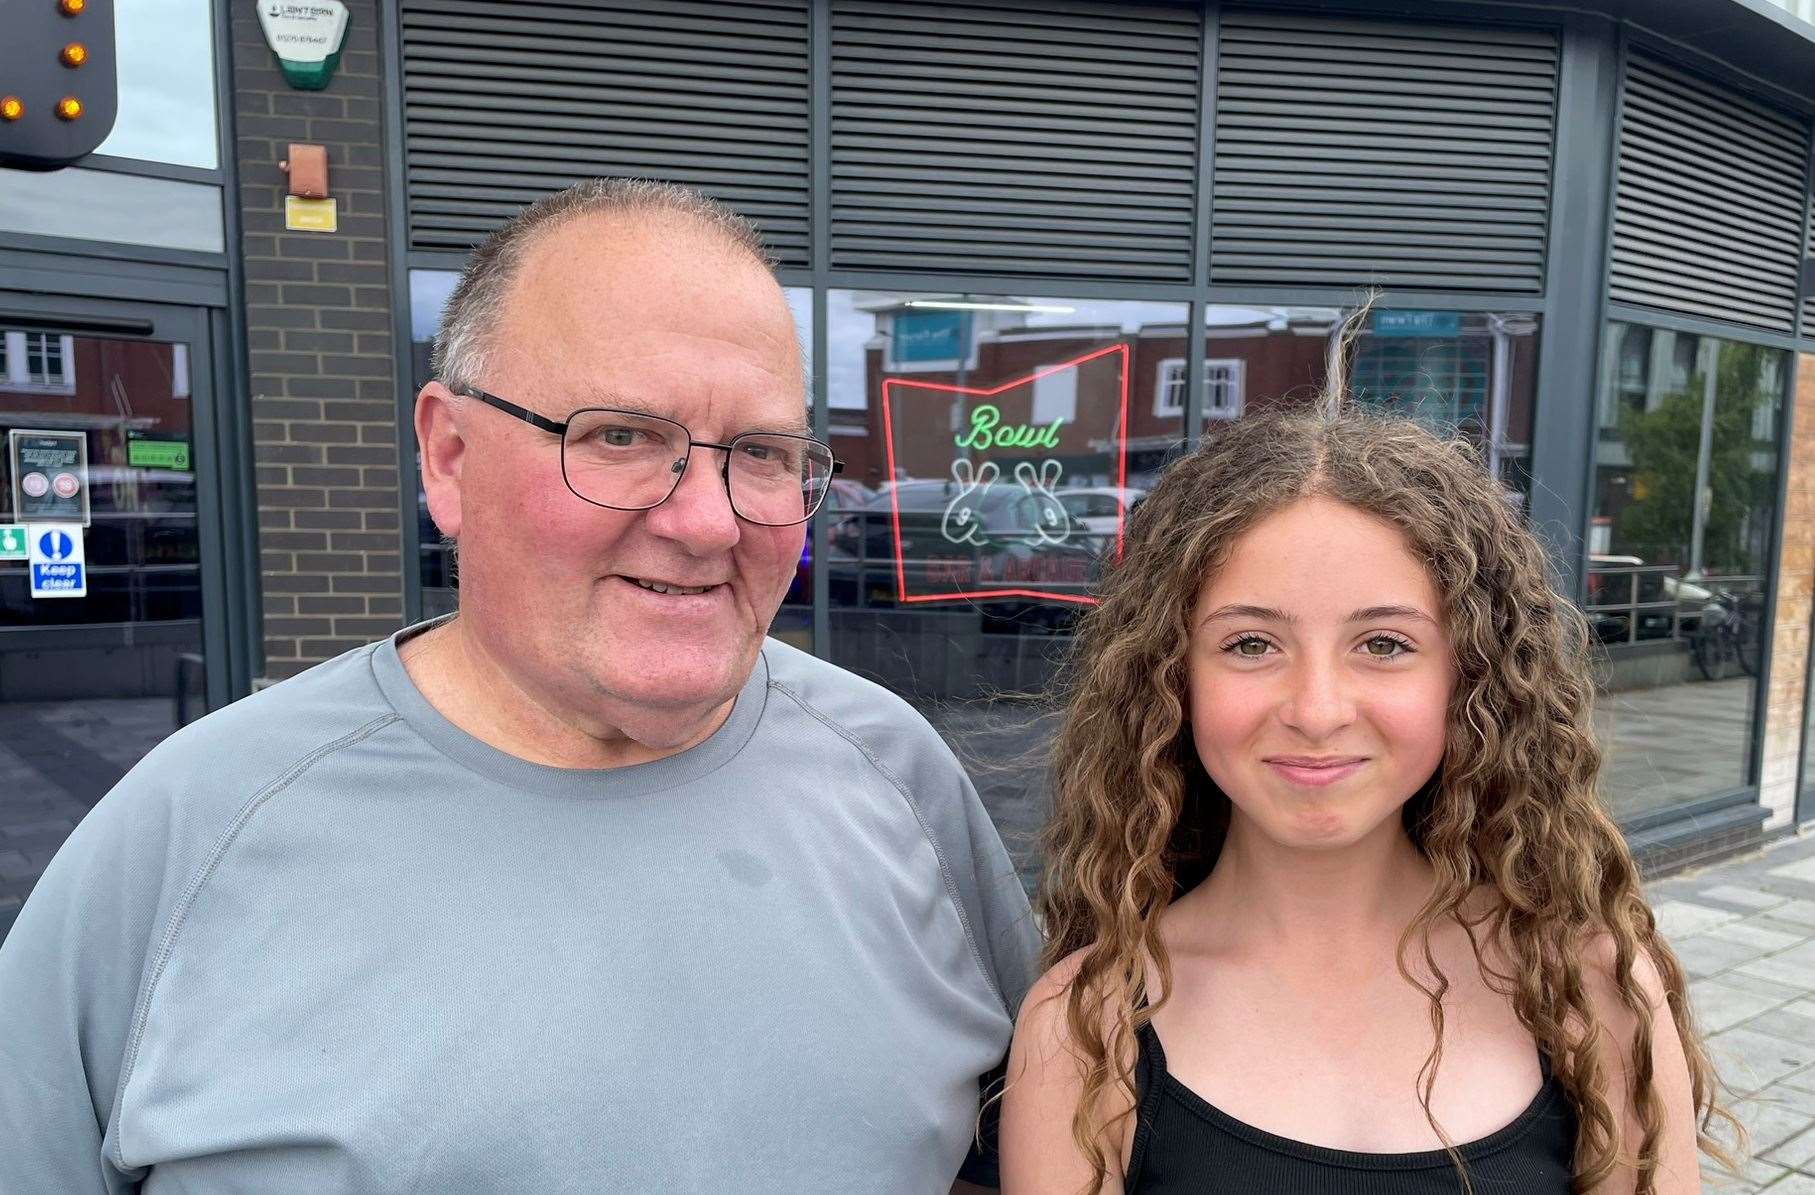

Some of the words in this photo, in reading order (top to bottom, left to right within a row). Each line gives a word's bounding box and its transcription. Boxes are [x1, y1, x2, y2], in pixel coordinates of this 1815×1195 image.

[954, 404, 1065, 451] Bowl
[40, 564, 76, 579] Keep
[41, 577, 77, 591] clear
